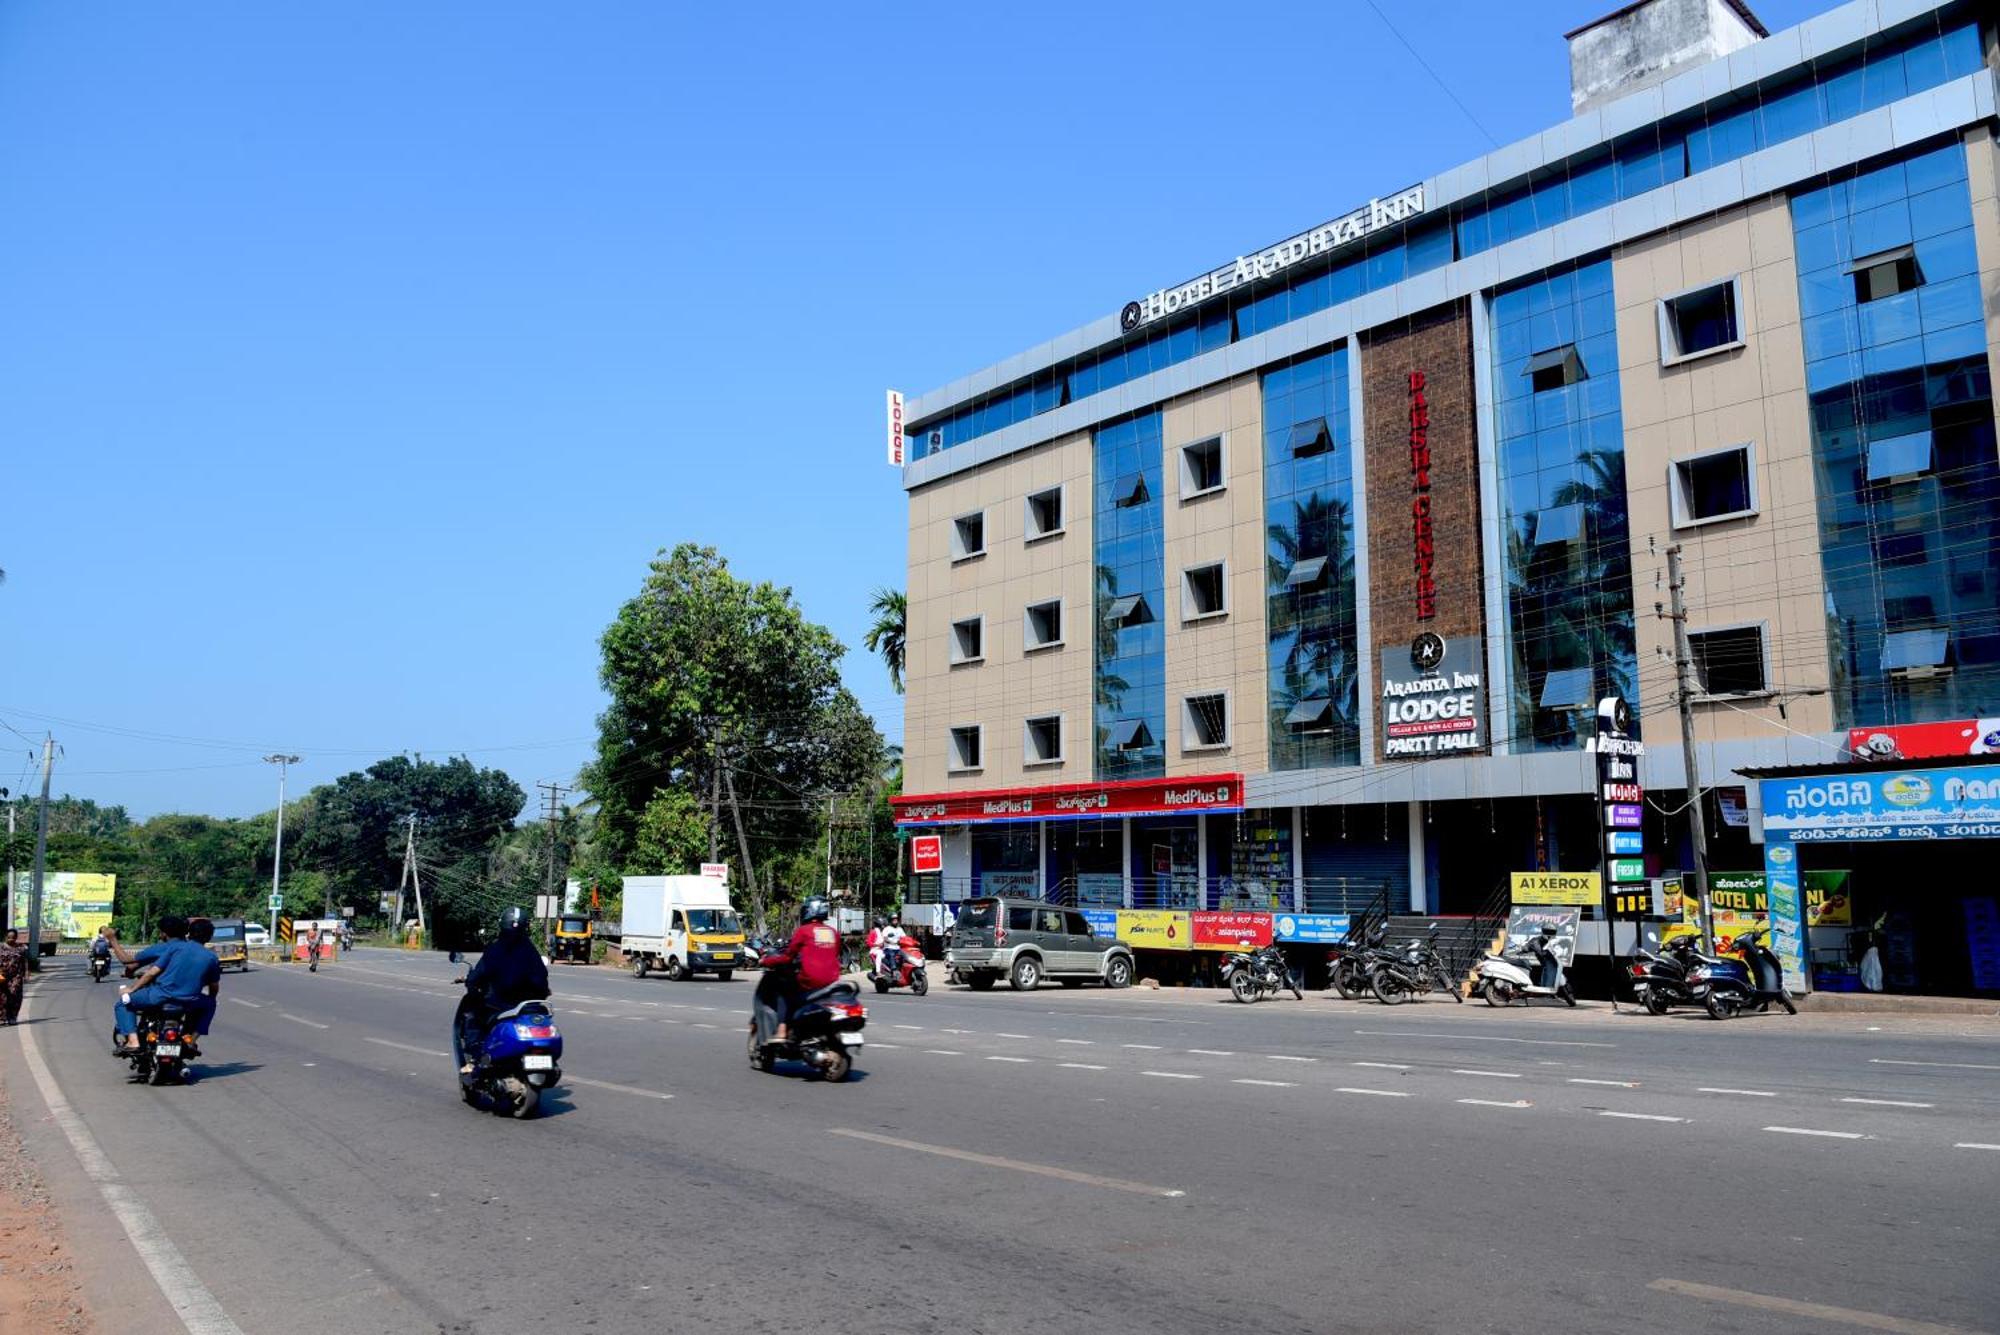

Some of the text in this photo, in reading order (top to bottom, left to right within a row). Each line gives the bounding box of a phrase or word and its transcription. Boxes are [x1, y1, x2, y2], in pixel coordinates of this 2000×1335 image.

[1147, 188, 1425, 320] HOTEL ARADHYA INN
[893, 393, 902, 463] LODGE
[1384, 671, 1480, 697] ARADHYA INN
[1388, 694, 1474, 723] LODGE
[1386, 733, 1479, 755] PARTY HALL
[984, 801, 1021, 814] MedPlus
[1164, 788, 1215, 805] MedPlus
[1786, 781, 1872, 809] ನಂದಿನಿ
[1520, 878, 1590, 889] A1 XEROX
